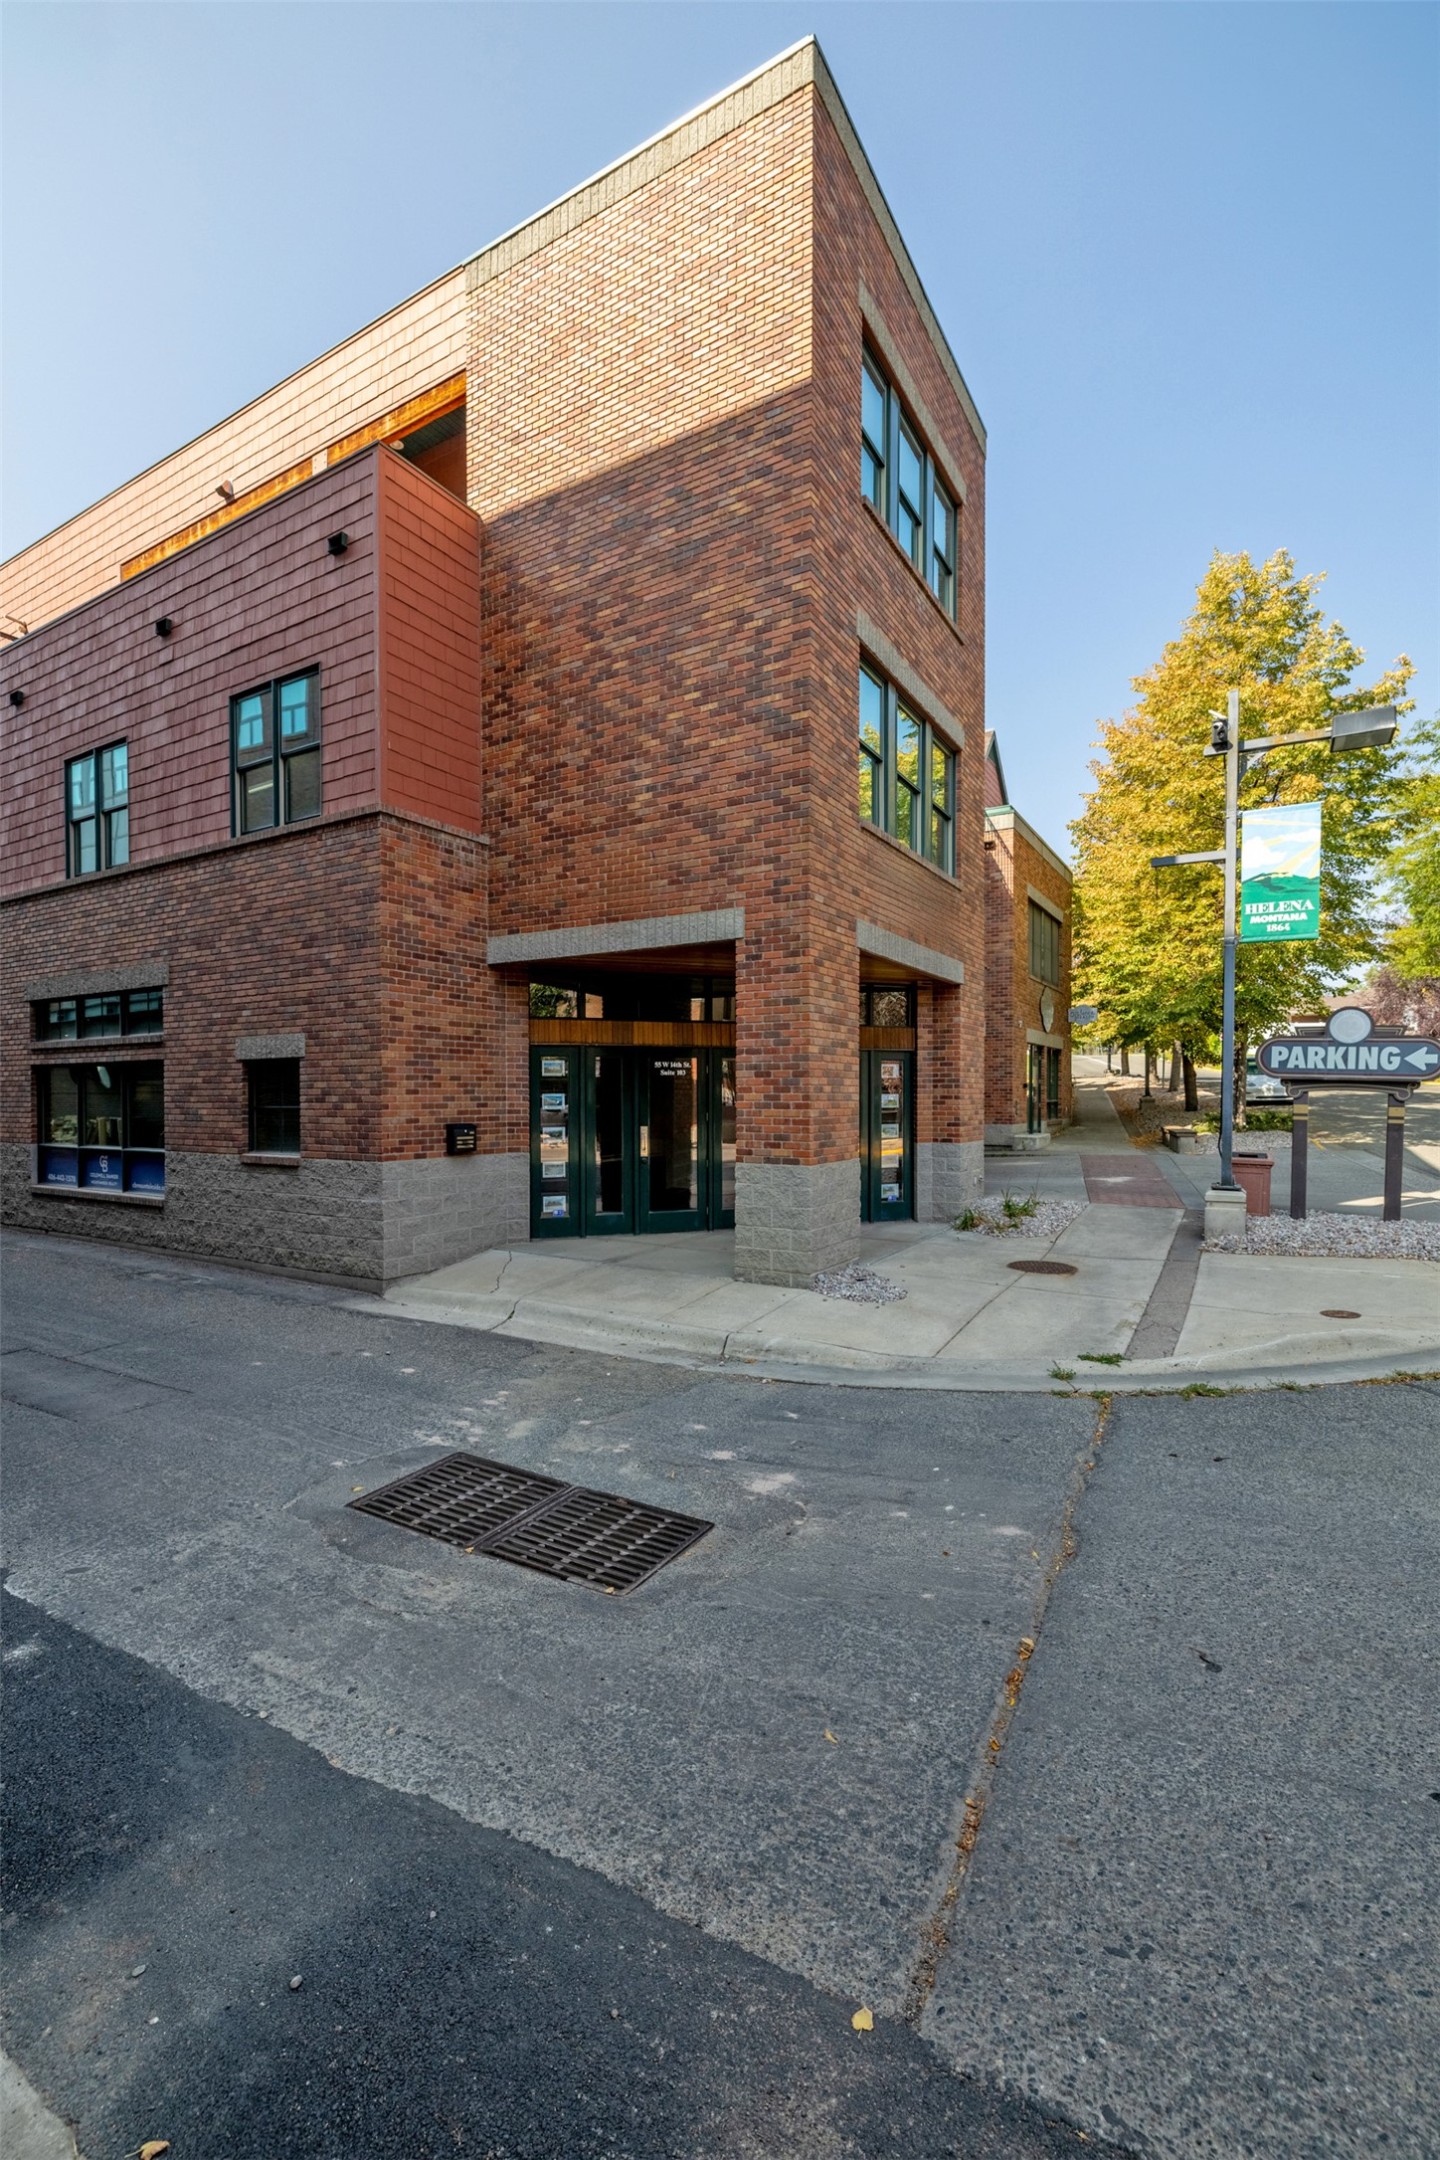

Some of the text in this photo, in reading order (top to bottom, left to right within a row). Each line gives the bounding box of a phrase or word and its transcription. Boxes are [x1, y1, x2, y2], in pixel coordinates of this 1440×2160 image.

[1244, 899, 1314, 915] HELENA
[1250, 912, 1308, 924] MONTANA
[1266, 923, 1290, 932] 1864
[1271, 1045, 1400, 1071] PARKING
